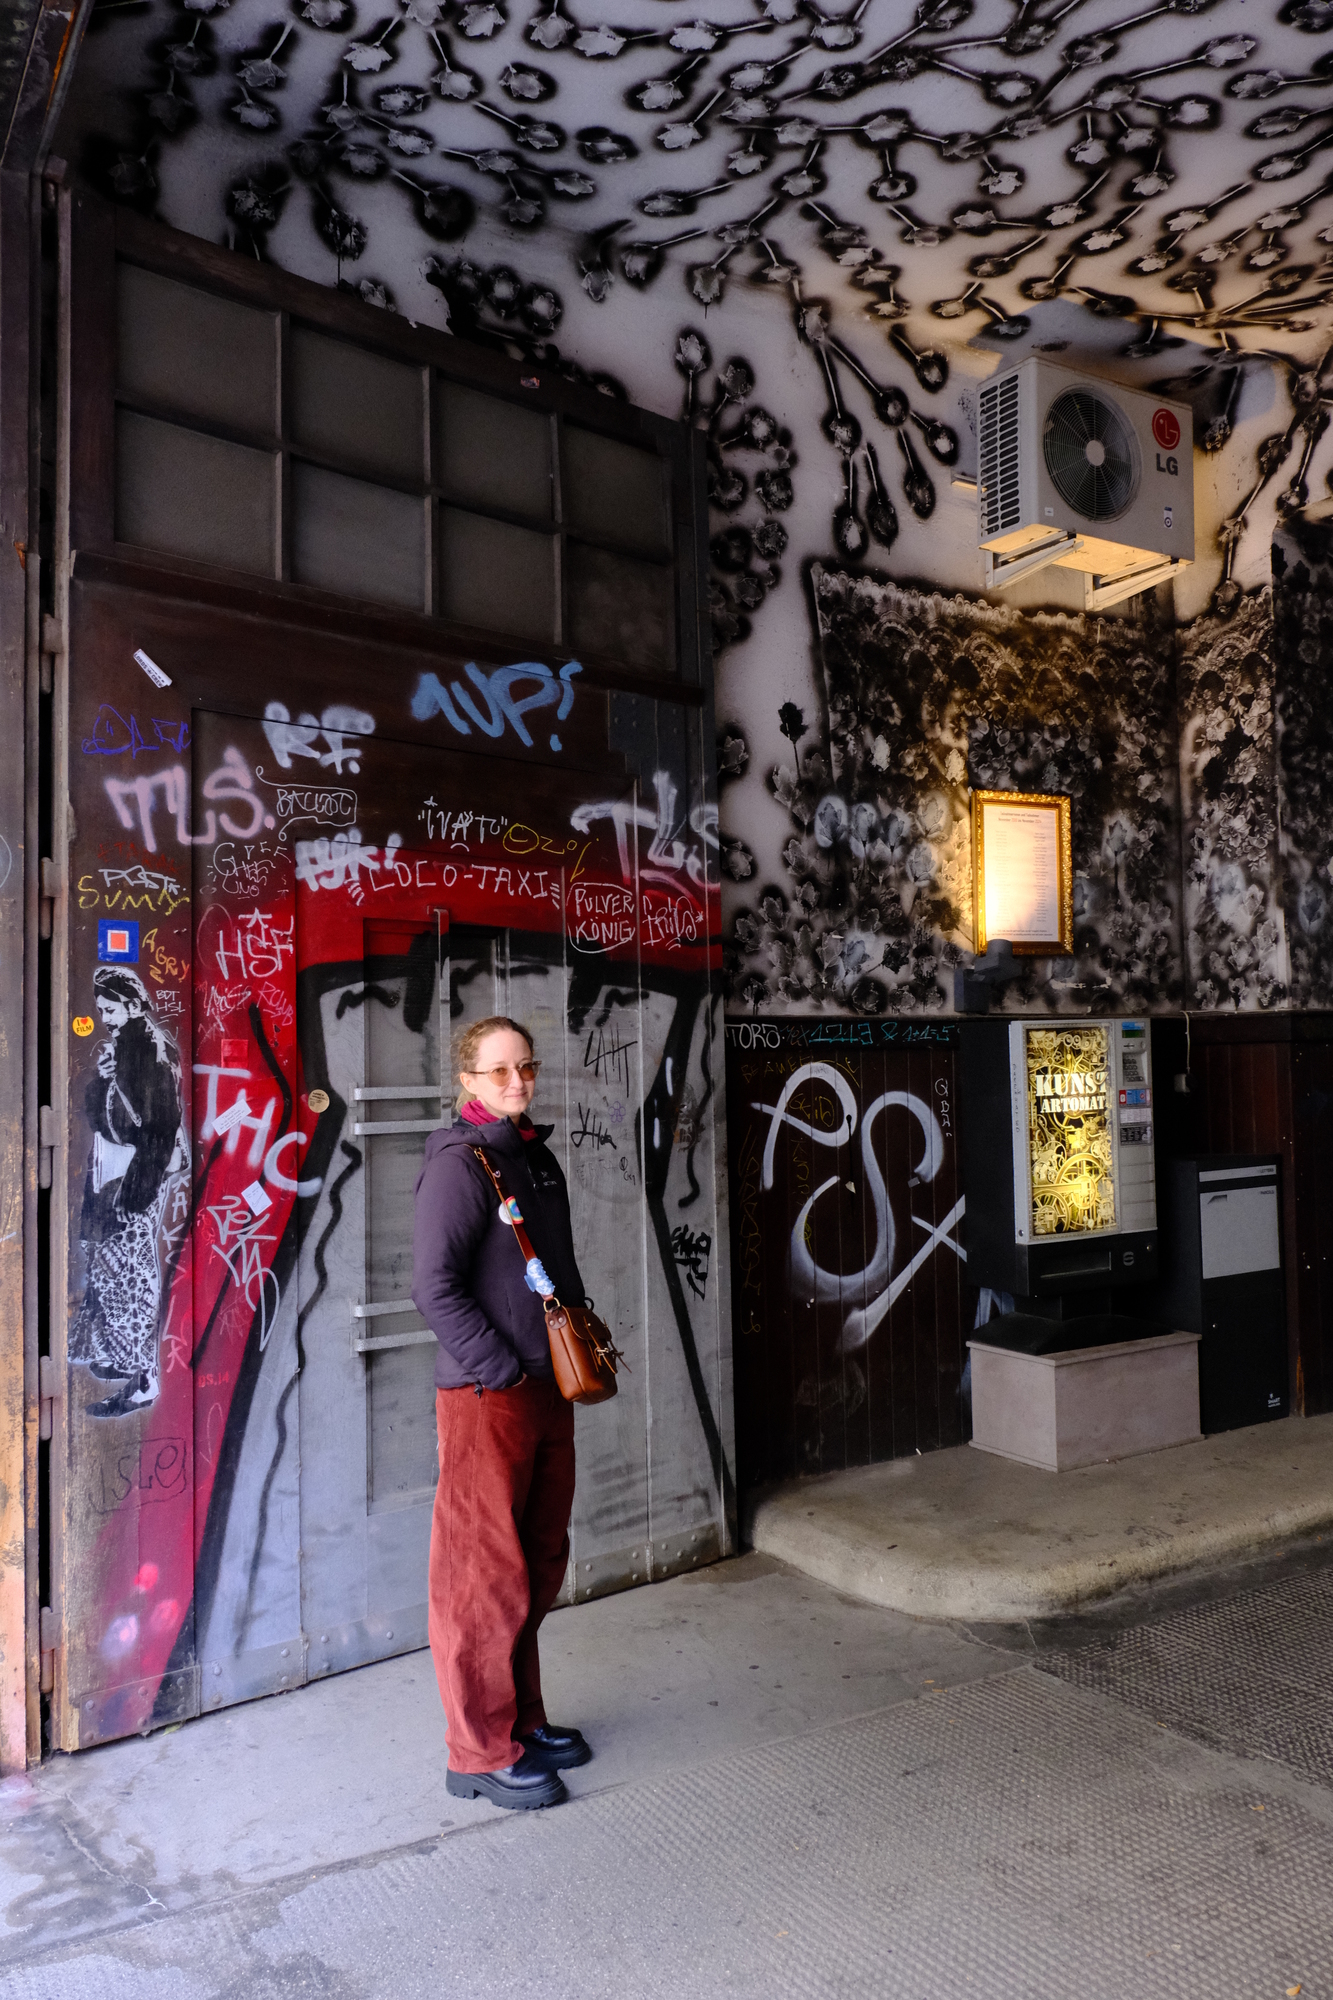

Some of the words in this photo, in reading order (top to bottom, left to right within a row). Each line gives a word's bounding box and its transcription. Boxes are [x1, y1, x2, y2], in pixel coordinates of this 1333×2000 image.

[1156, 453, 1179, 476] LG
[574, 886, 635, 917] PULVER
[575, 917, 636, 945] KÖNIG
[156, 990, 180, 1001] BDT
[156, 1002, 186, 1013] HSL
[76, 1025, 92, 1034] FILM
[1035, 1072, 1108, 1097] KUNST
[1040, 1096, 1106, 1114] ARTOMAT
